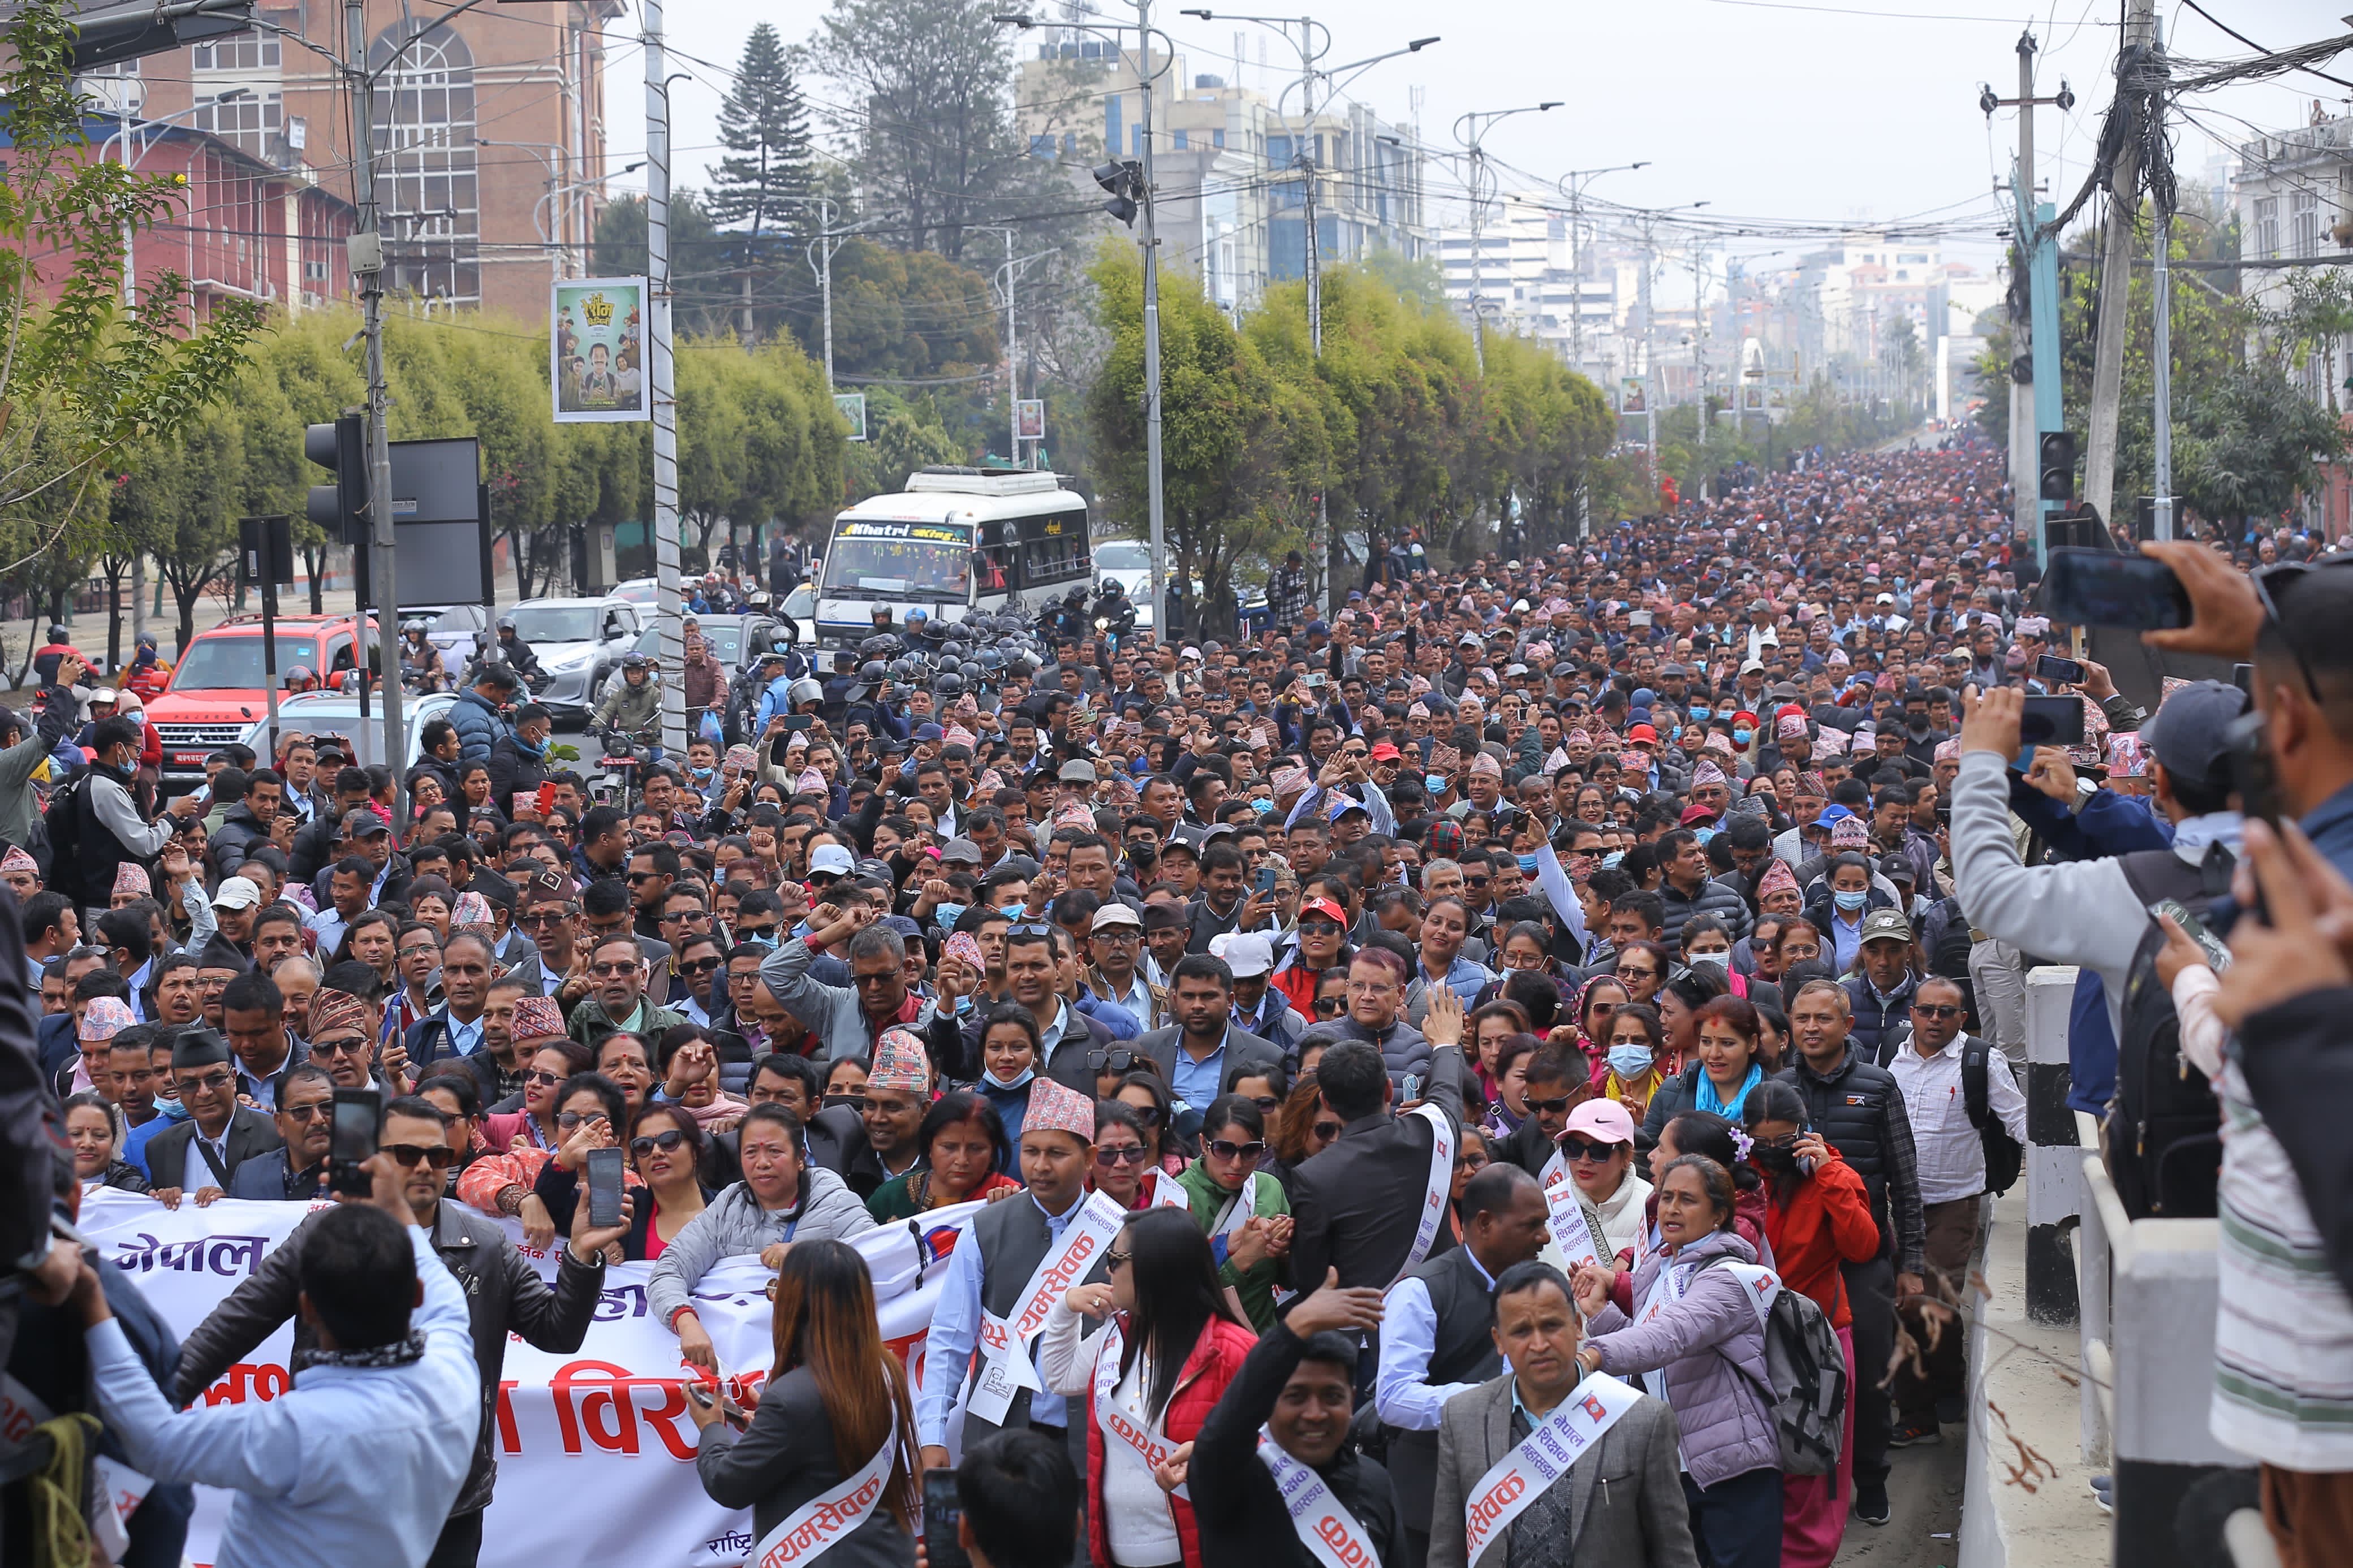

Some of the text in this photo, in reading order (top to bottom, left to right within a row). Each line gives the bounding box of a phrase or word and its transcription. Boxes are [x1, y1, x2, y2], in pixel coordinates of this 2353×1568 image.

[851, 524, 910, 537] Khatri
[1552, 1206, 1577, 1226] नेपाल
[1556, 1216, 1583, 1242] शिक्षक
[111, 1233, 270, 1276] नेपाल
[1536, 1426, 1572, 1464] शिक्षक
[1553, 1414, 1586, 1448] नेपाल
